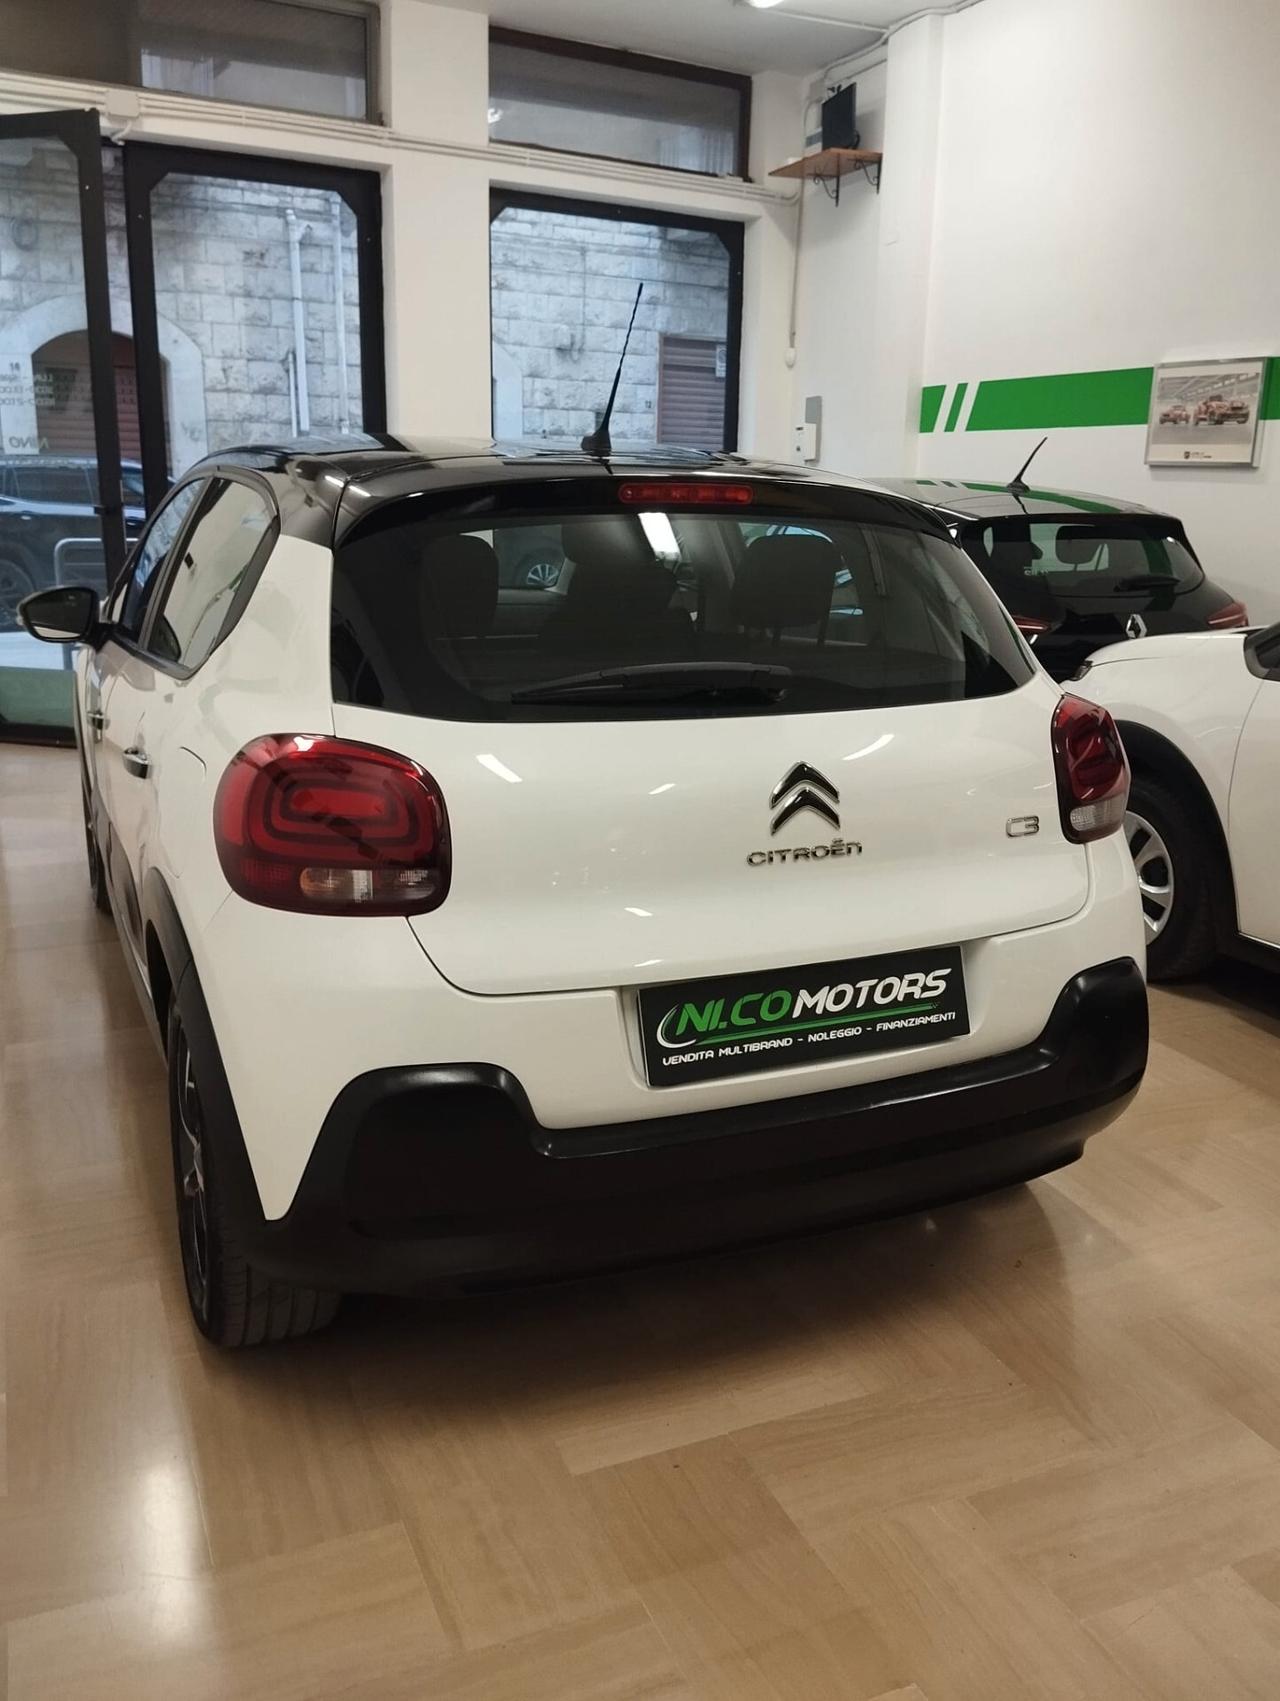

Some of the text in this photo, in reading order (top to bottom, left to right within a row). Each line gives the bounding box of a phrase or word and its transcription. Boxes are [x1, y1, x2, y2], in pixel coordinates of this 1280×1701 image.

[1005, 815, 1040, 838] C3
[662, 1049, 715, 1066] VENDITA
[718, 1037, 793, 1056] MULTIBRAND
[807, 1026, 862, 1043] NOLEGGIO
[875, 1012, 956, 1032] FINANZIAMENTI
